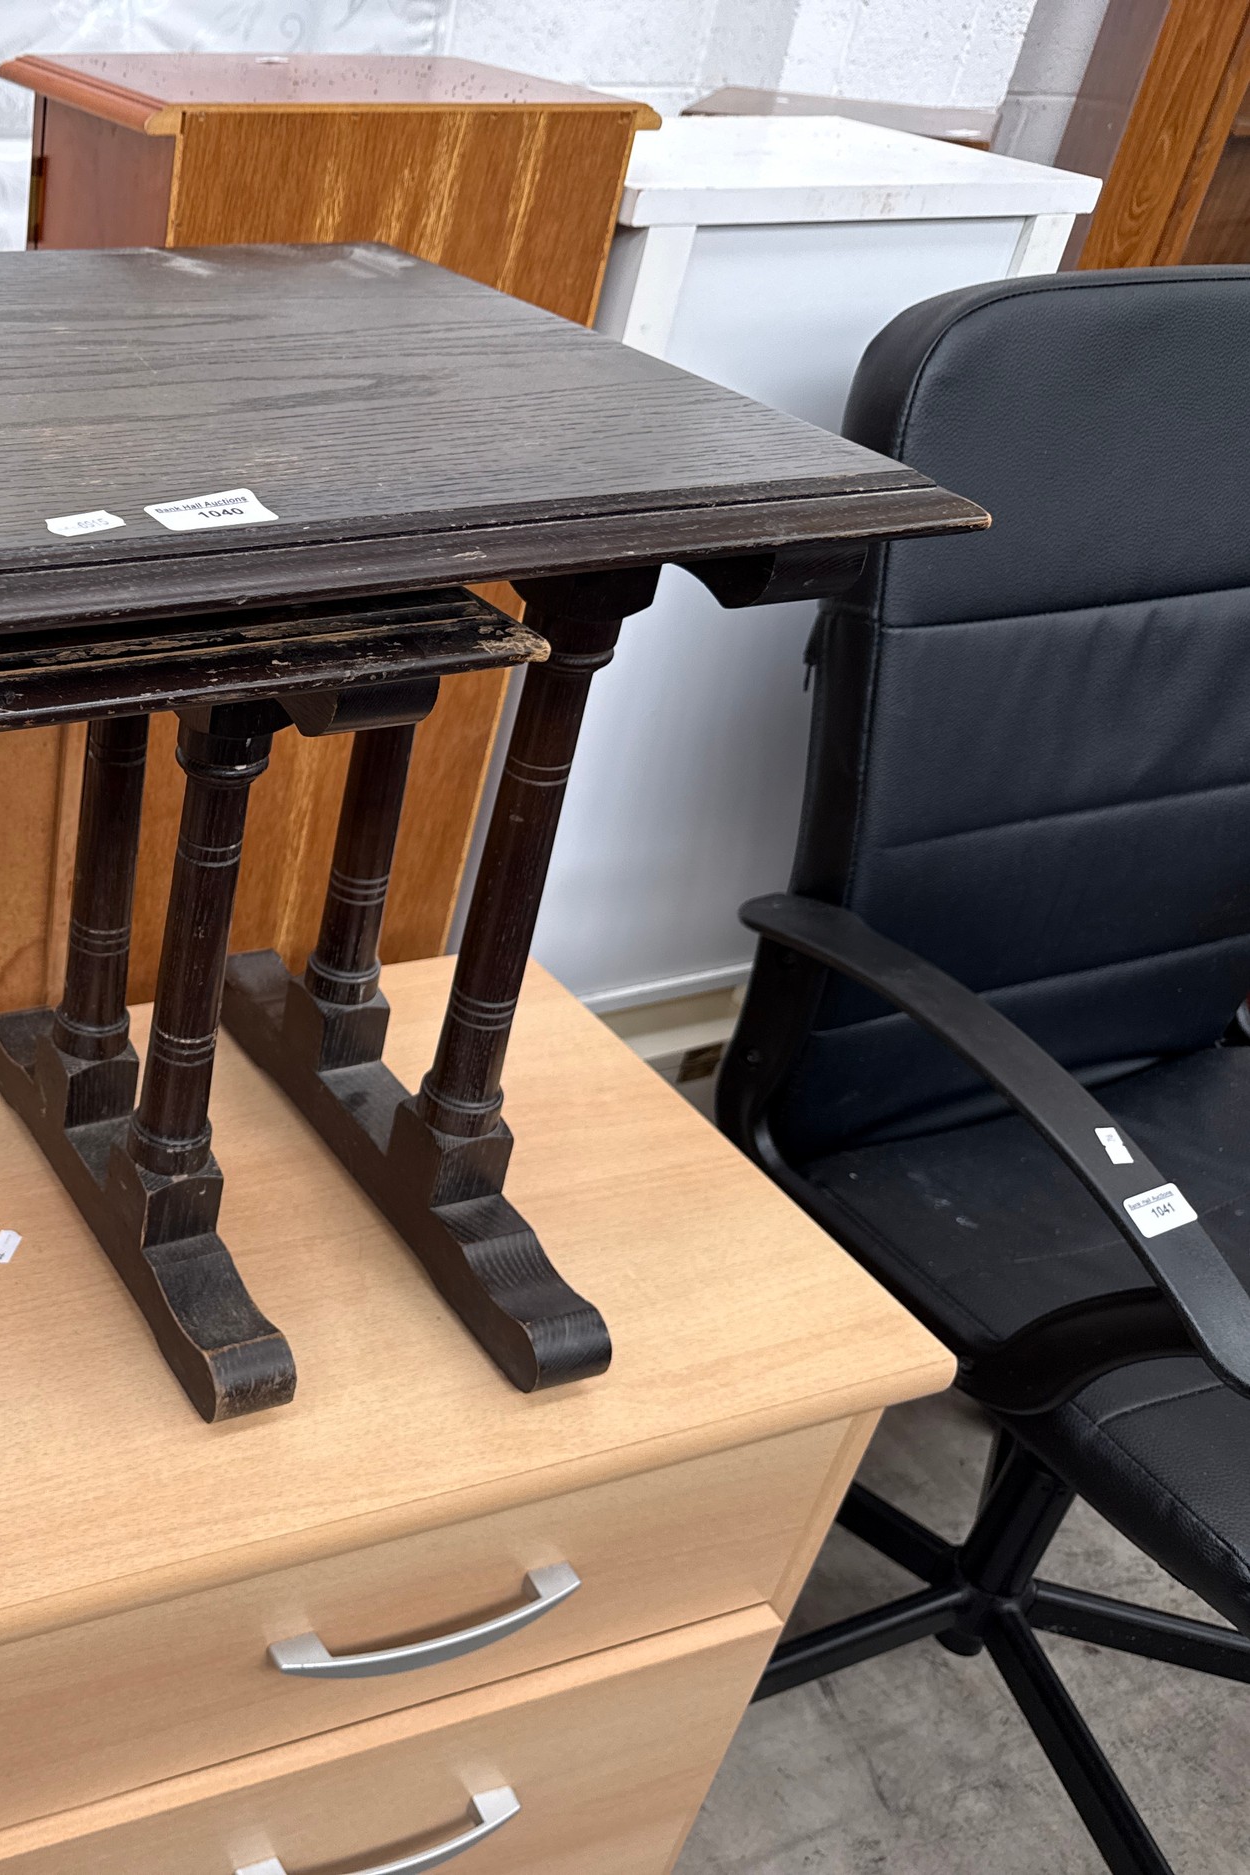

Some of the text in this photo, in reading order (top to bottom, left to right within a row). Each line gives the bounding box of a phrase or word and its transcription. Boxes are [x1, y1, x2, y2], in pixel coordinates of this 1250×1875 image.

[182, 502, 202, 511] Hall
[204, 495, 248, 508] Auctions
[198, 507, 244, 519] 1040
[1151, 1202, 1175, 1218] 1041
